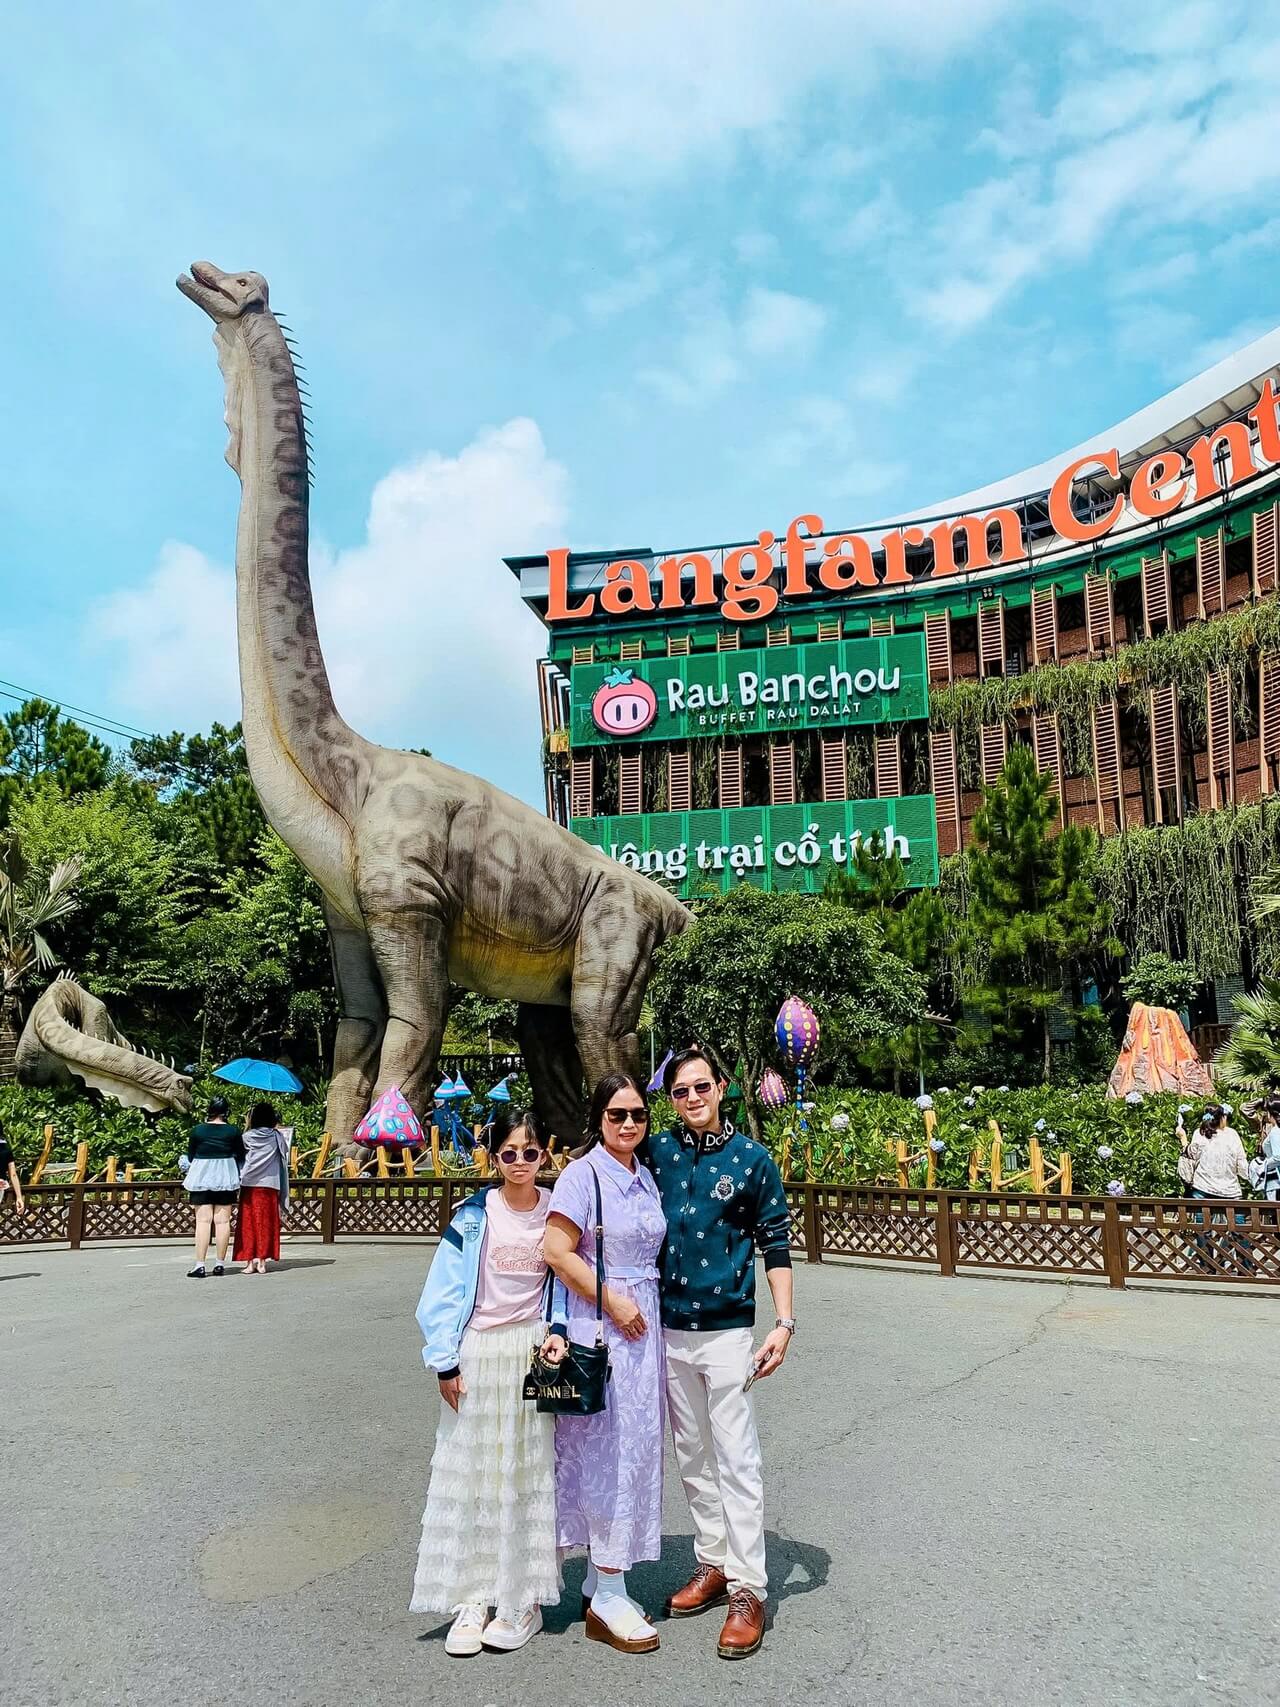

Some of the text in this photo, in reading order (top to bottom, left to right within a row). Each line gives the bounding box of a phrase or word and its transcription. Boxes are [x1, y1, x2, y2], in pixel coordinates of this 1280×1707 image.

[545, 507, 1028, 621] Langfarm
[667, 665, 900, 712] Rau Banchou
[699, 702, 861, 725] BUFFET RAU DALAT
[695, 834, 767, 877] trại
[774, 823, 821, 866] cổ
[537, 1385, 581, 1399] HANEL
